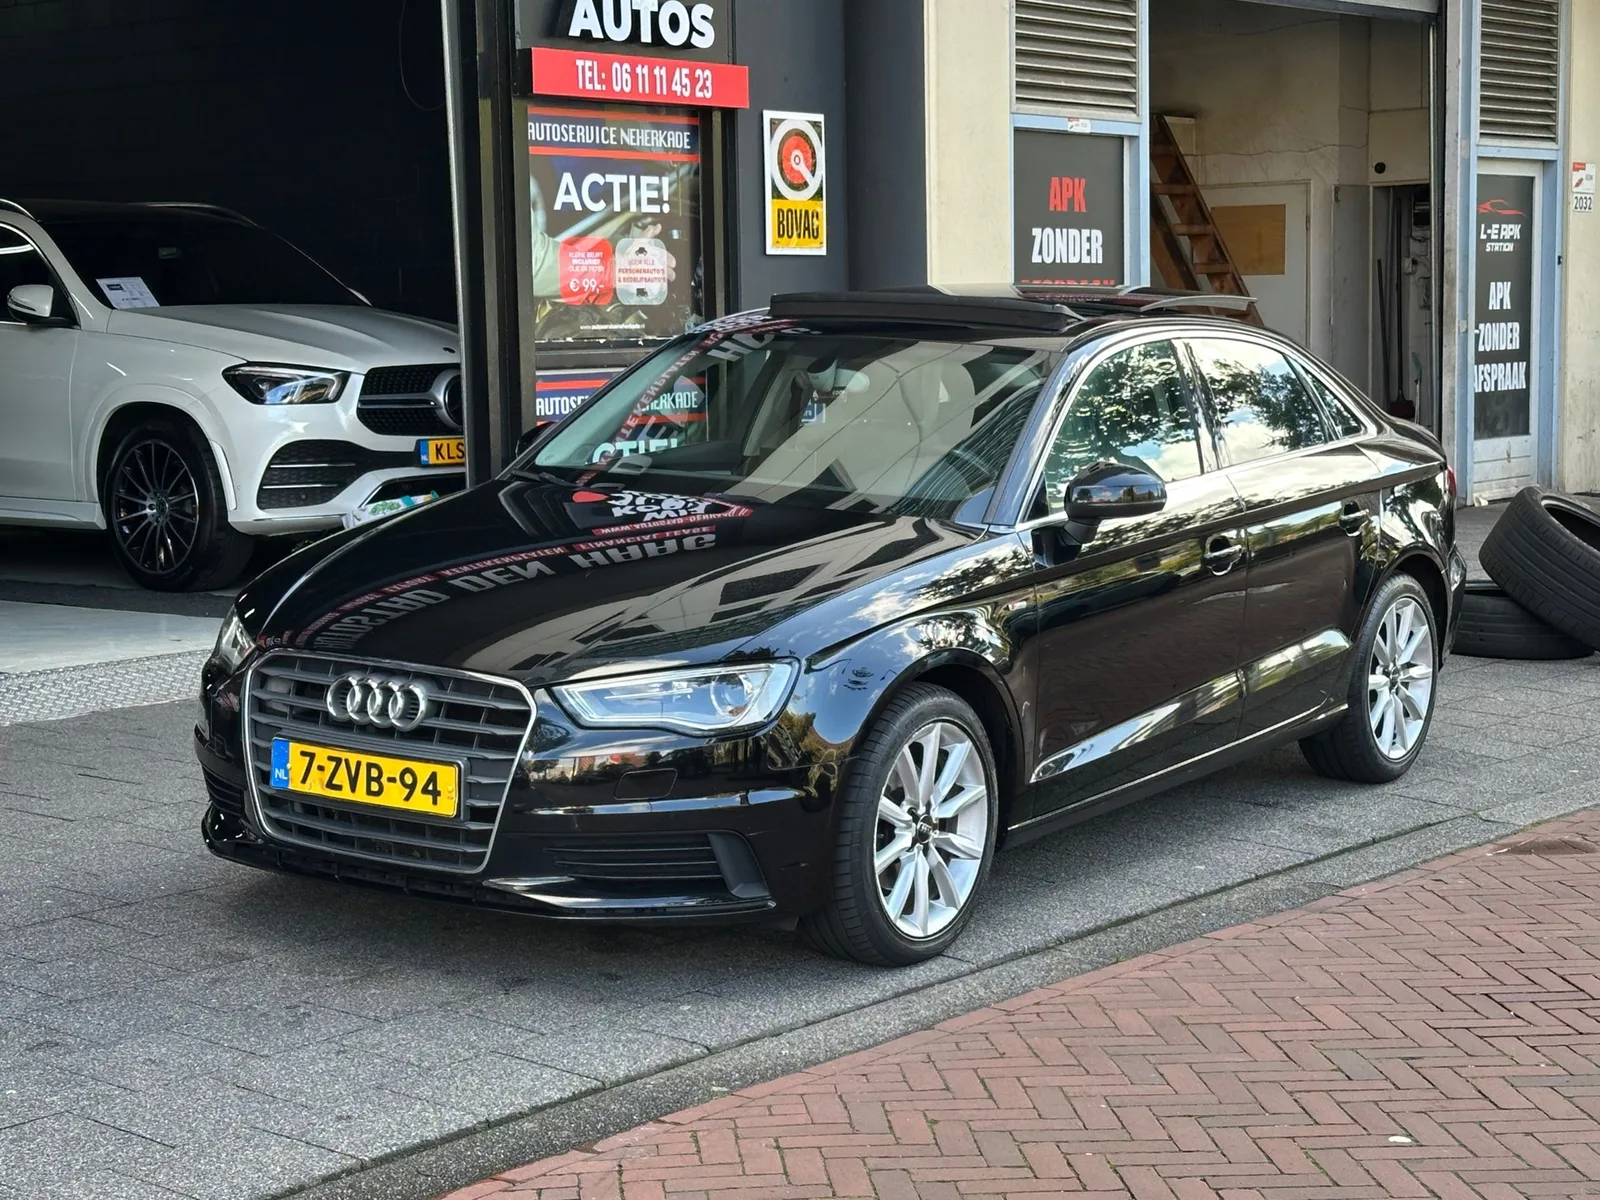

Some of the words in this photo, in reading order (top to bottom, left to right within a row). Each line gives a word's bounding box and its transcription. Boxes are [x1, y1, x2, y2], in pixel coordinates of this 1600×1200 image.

[568, 0, 716, 49] AUTOS
[575, 59, 607, 91] TEL:
[611, 61, 632, 94] 06
[636, 64, 650, 95] 11
[653, 65, 668, 96] 11
[671, 67, 691, 97] 45
[695, 68, 713, 99] 23
[528, 122, 618, 145] AUTOSERVICE
[620, 127, 691, 149] NEHERKADE
[554, 172, 671, 214] ACTIE!
[1049, 176, 1087, 213] APK
[1574, 196, 1593, 211] 2032
[1031, 227, 1103, 264] ZONDER
[1480, 223, 1500, 240] L-E
[1500, 223, 1522, 240] APK
[1485, 242, 1514, 252] STATION
[569, 278, 580, 292] €
[1488, 281, 1512, 311] APK
[1477, 322, 1520, 352] ZONDER
[274, 768, 288, 780] NL
[299, 751, 442, 806] 7-ZVB-94
